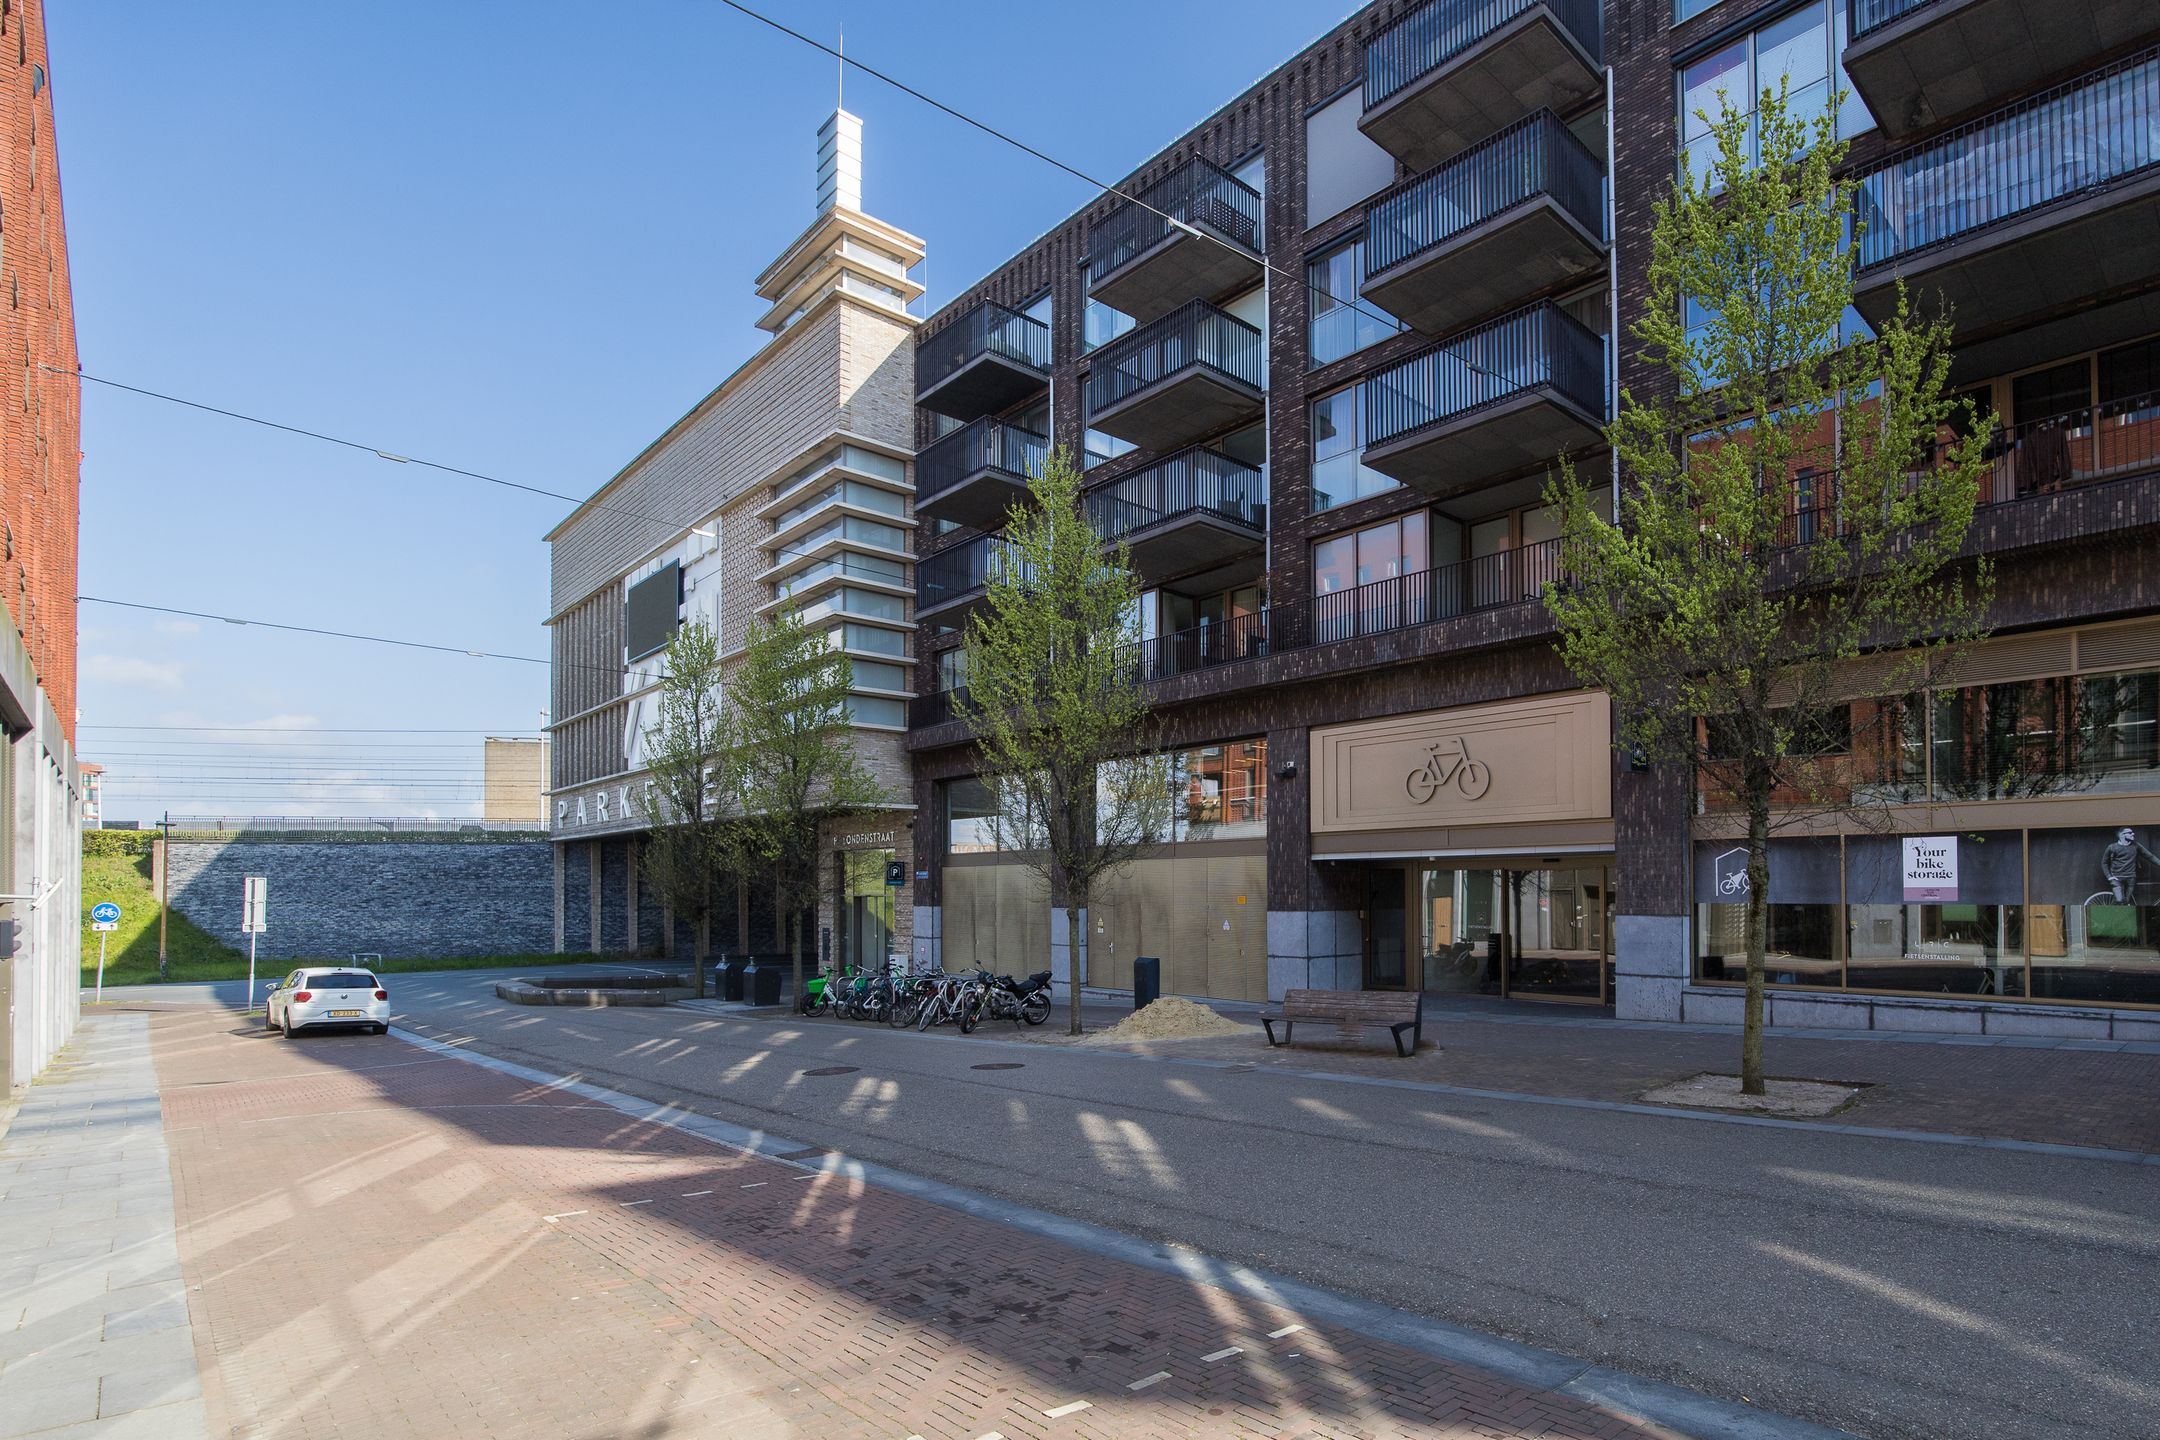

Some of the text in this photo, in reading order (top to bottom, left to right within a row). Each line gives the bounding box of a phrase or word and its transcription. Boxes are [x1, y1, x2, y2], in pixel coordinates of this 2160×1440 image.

[1913, 846, 1947, 857] Your
[1916, 858, 1944, 868] bike
[892, 868, 899, 877] P
[1907, 870, 1953, 879] storage
